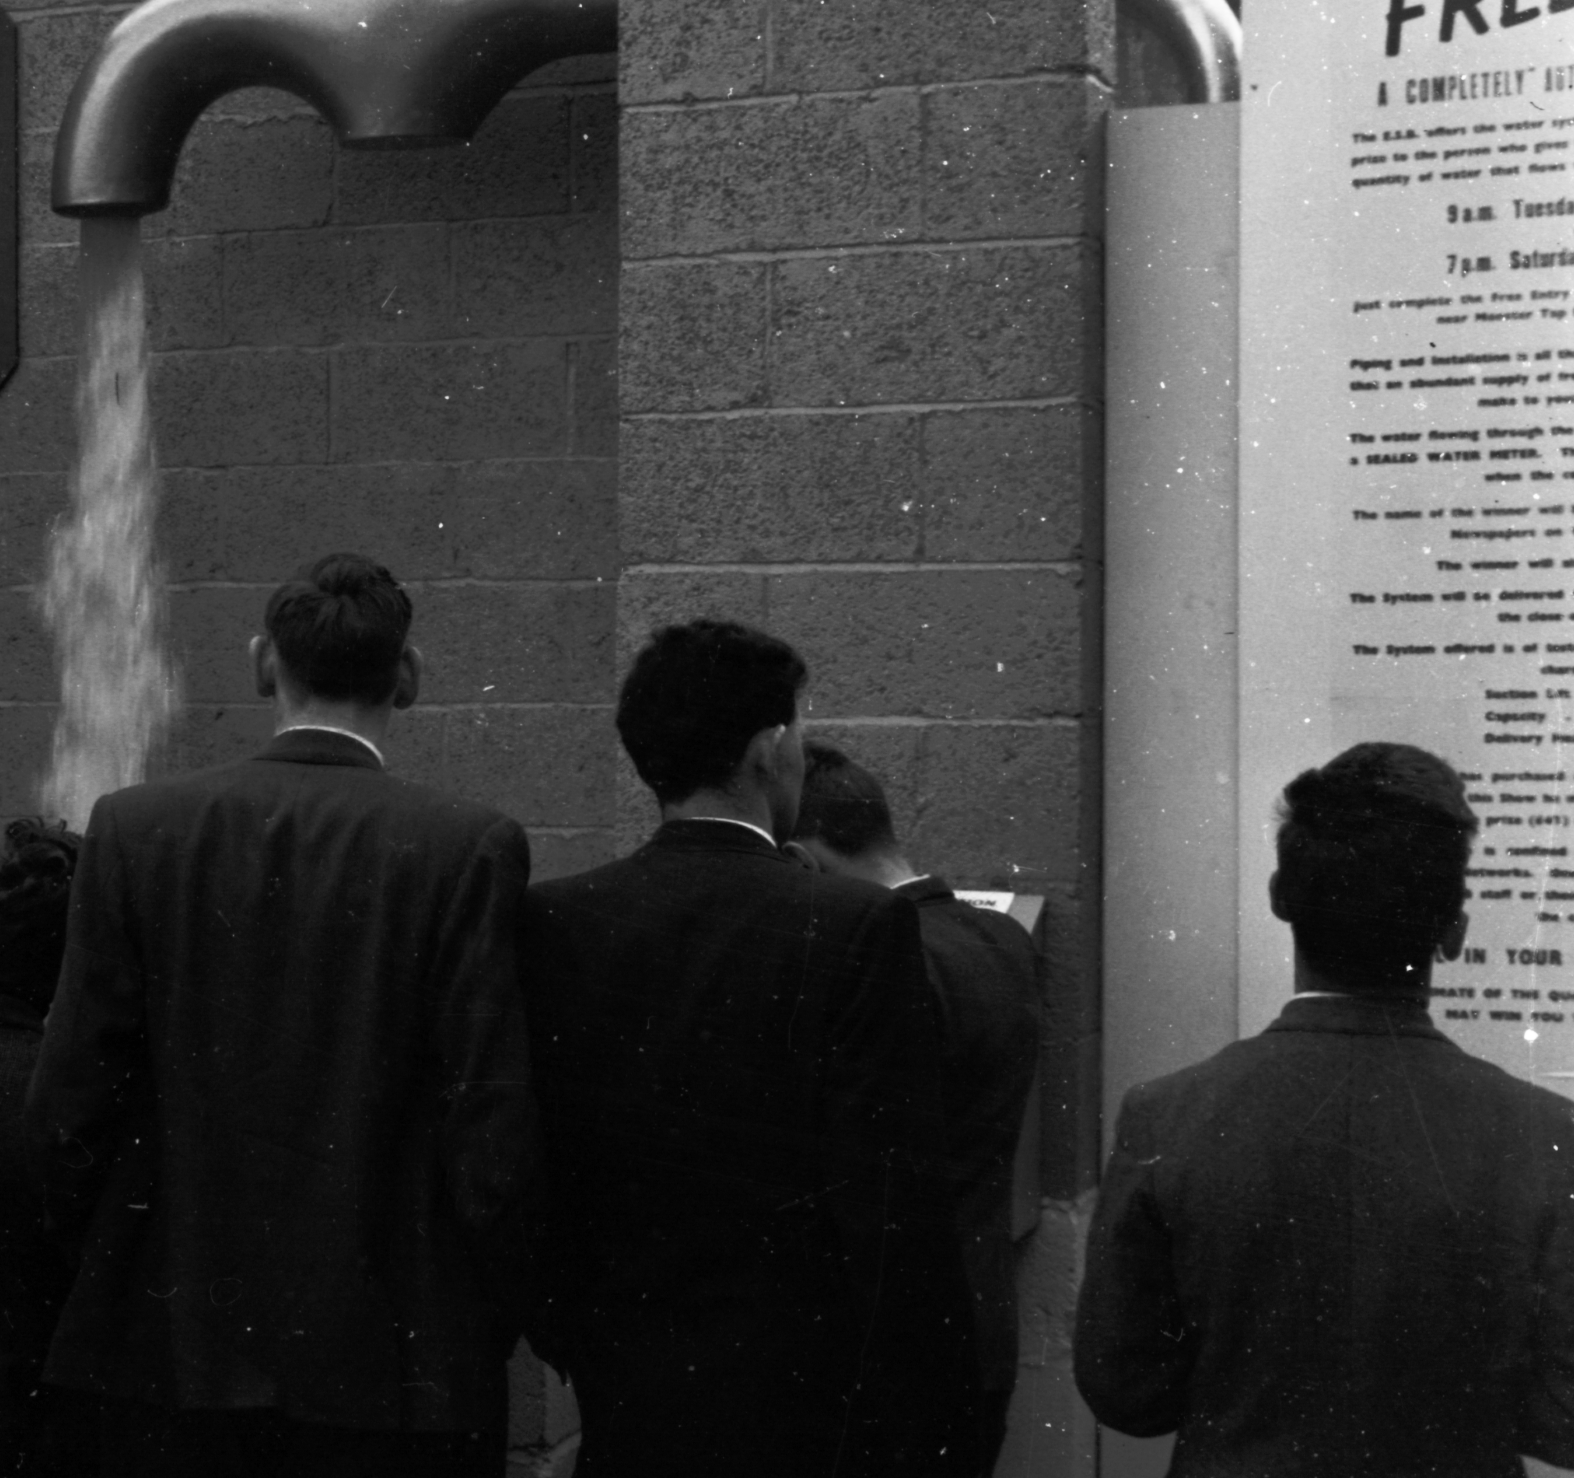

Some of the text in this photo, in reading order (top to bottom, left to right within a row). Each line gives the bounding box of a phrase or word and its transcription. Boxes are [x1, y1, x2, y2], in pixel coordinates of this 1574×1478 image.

[1377, 82, 1388, 106] A
[1405, 70, 1523, 104] COMPLETELY
[1513, 198, 1574, 217] Tuesda
[1510, 250, 1574, 269] Saturda
[1464, 948, 1562, 965] IN YOUR
